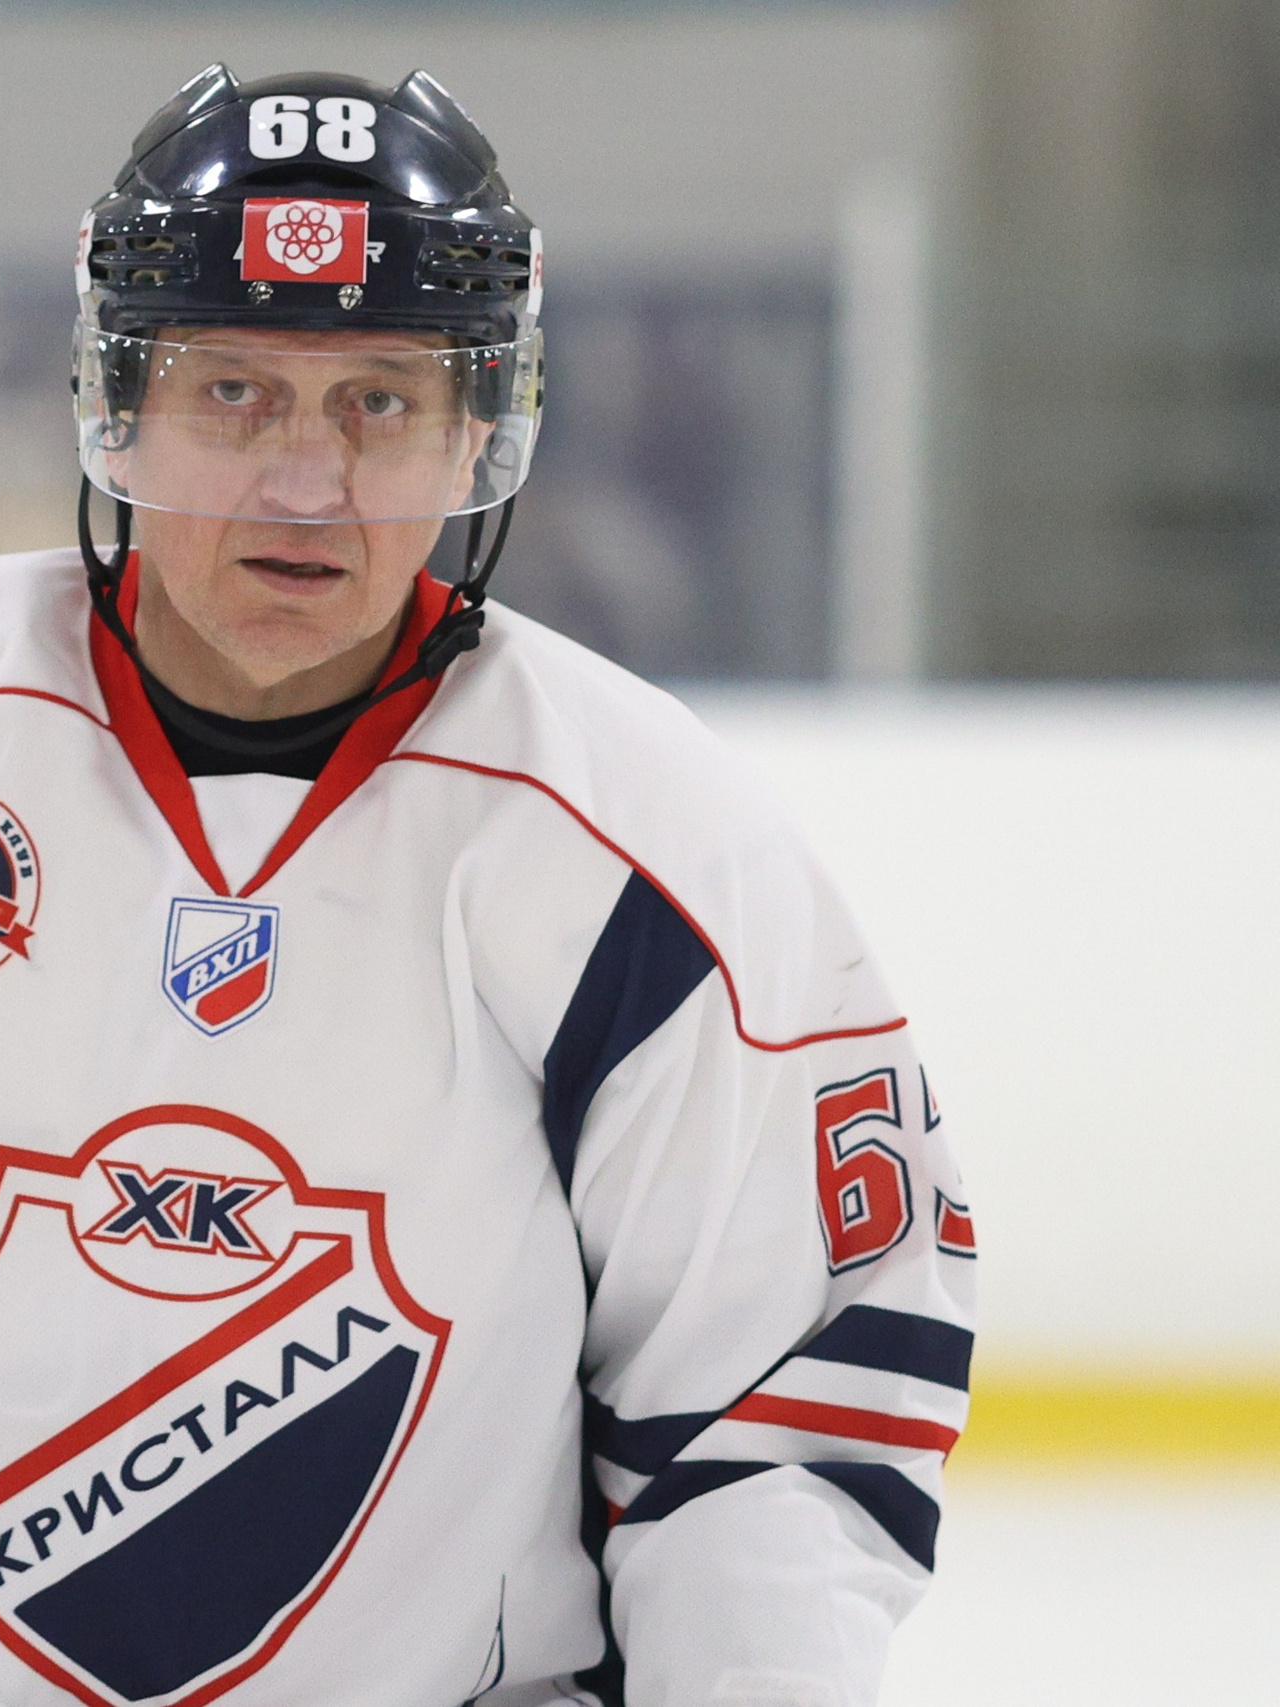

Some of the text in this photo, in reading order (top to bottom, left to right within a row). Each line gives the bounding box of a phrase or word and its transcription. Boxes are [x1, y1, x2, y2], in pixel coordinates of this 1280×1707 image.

[249, 95, 376, 162] 68
[186, 932, 259, 996] ВХЛ
[90, 1163, 275, 1257] ХК
